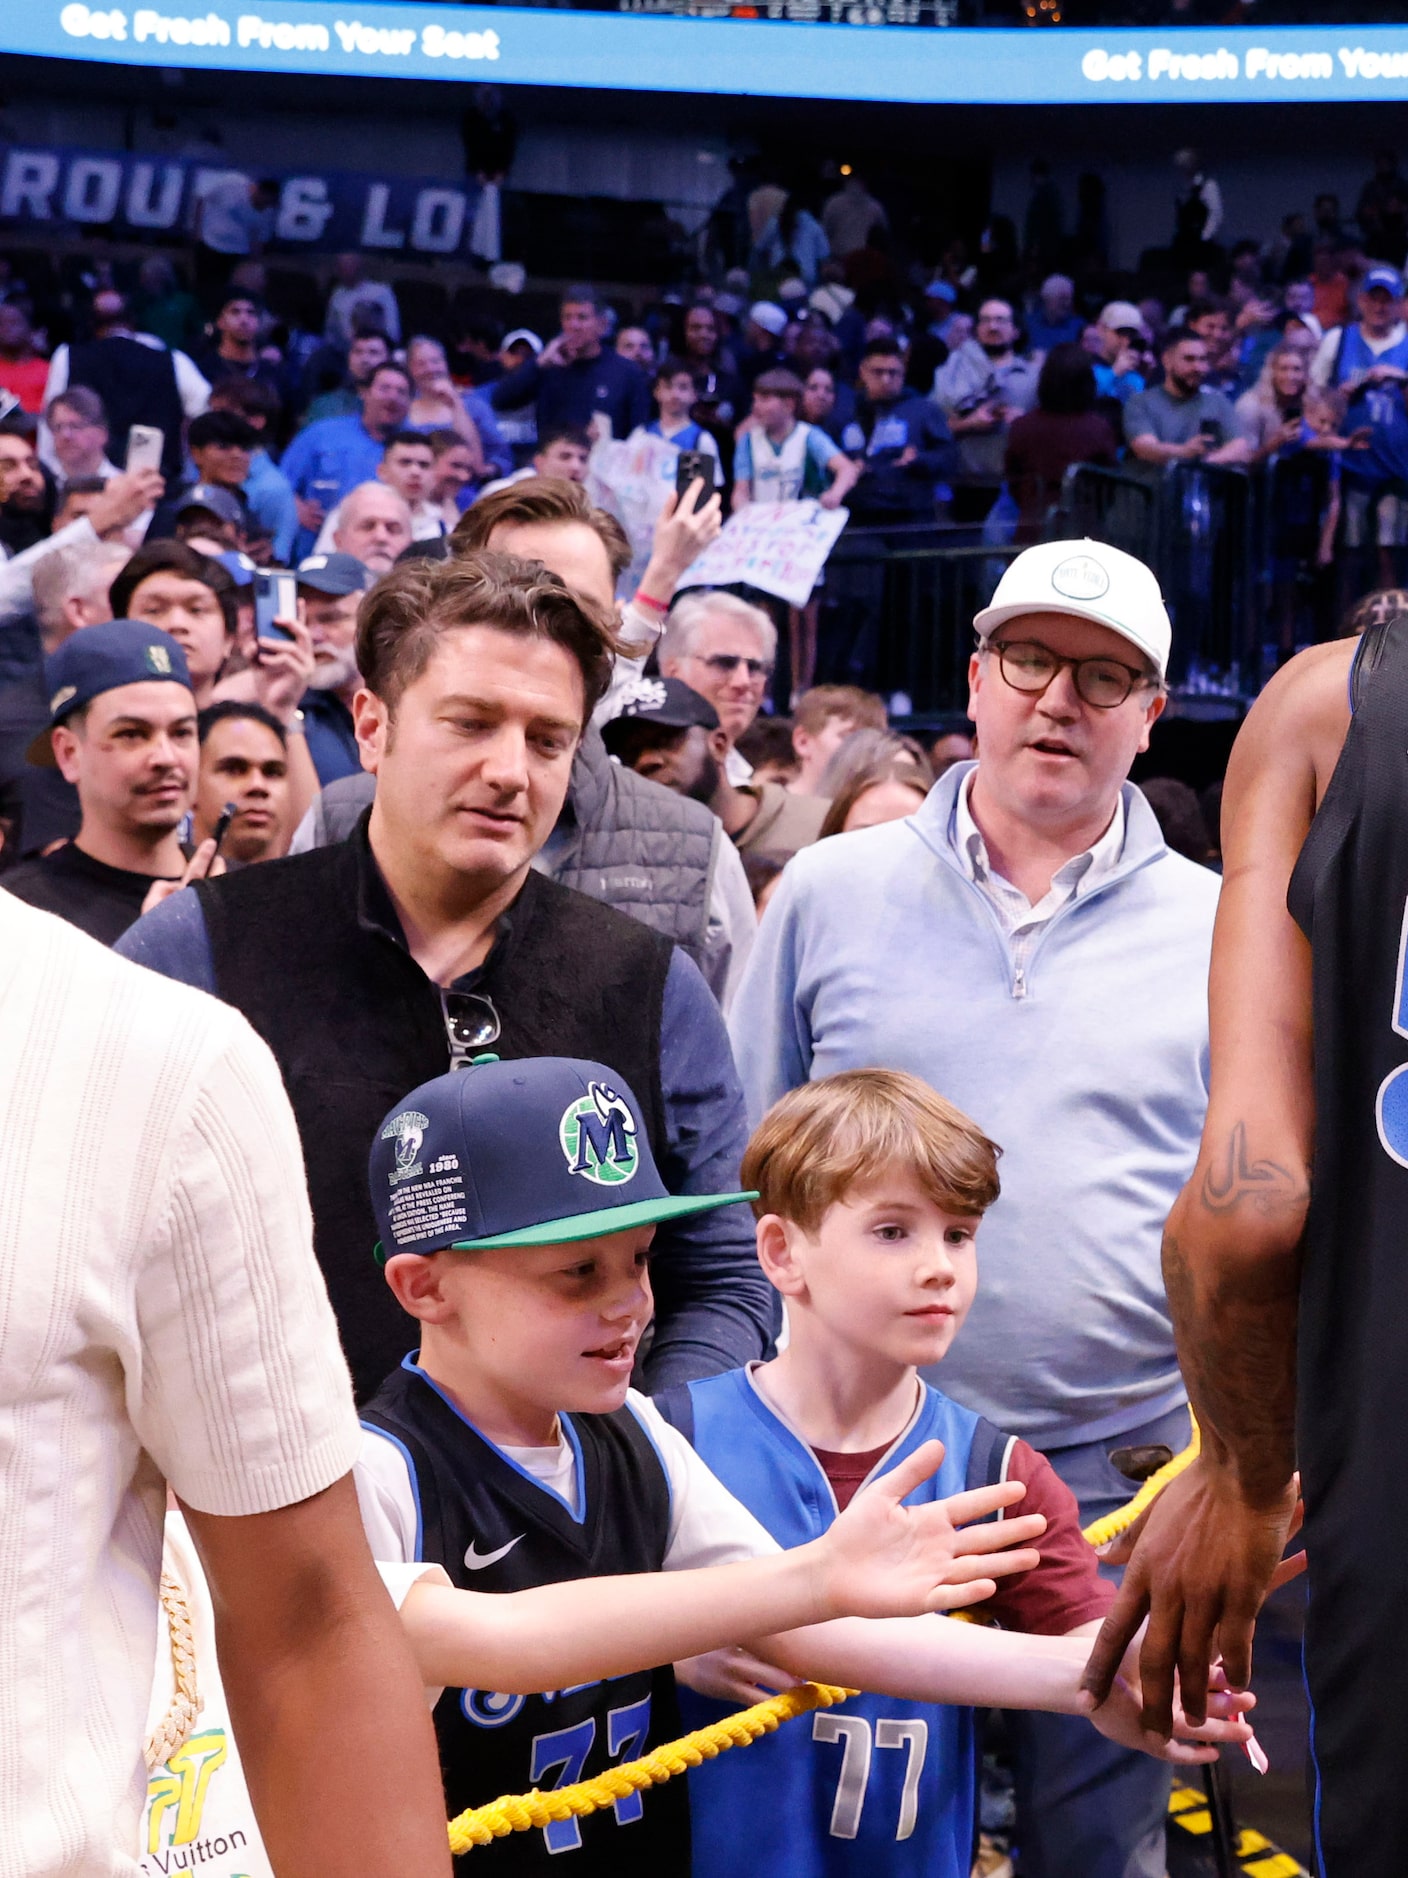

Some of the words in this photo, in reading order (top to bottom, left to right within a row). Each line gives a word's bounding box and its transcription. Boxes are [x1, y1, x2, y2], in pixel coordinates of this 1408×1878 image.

[61, 3, 127, 41] Get
[134, 10, 230, 46] Fresh
[238, 15, 329, 51] From
[335, 20, 416, 56] Your
[422, 24, 500, 60] Seat
[1082, 48, 1142, 81] Get
[1148, 47, 1239, 80] Fresh
[1245, 47, 1333, 80] From
[2, 151, 249, 231] ROU
[275, 177, 334, 242] &
[361, 182, 467, 254] LO
[429, 1159, 459, 1174] 1980
[415, 1187, 443, 1200] REVEALED
[442, 1186, 452, 1194] ON
[423, 1181, 436, 1190] NBA
[416, 1197, 433, 1207] PRESS
[428, 1204, 439, 1213] THE
[438, 1201, 455, 1210] NAME
[453, 1215, 468, 1223] AND
[529, 1692, 653, 1855] 77
[812, 1711, 929, 1841] 77
[152, 1830, 247, 1875] Vuitton
